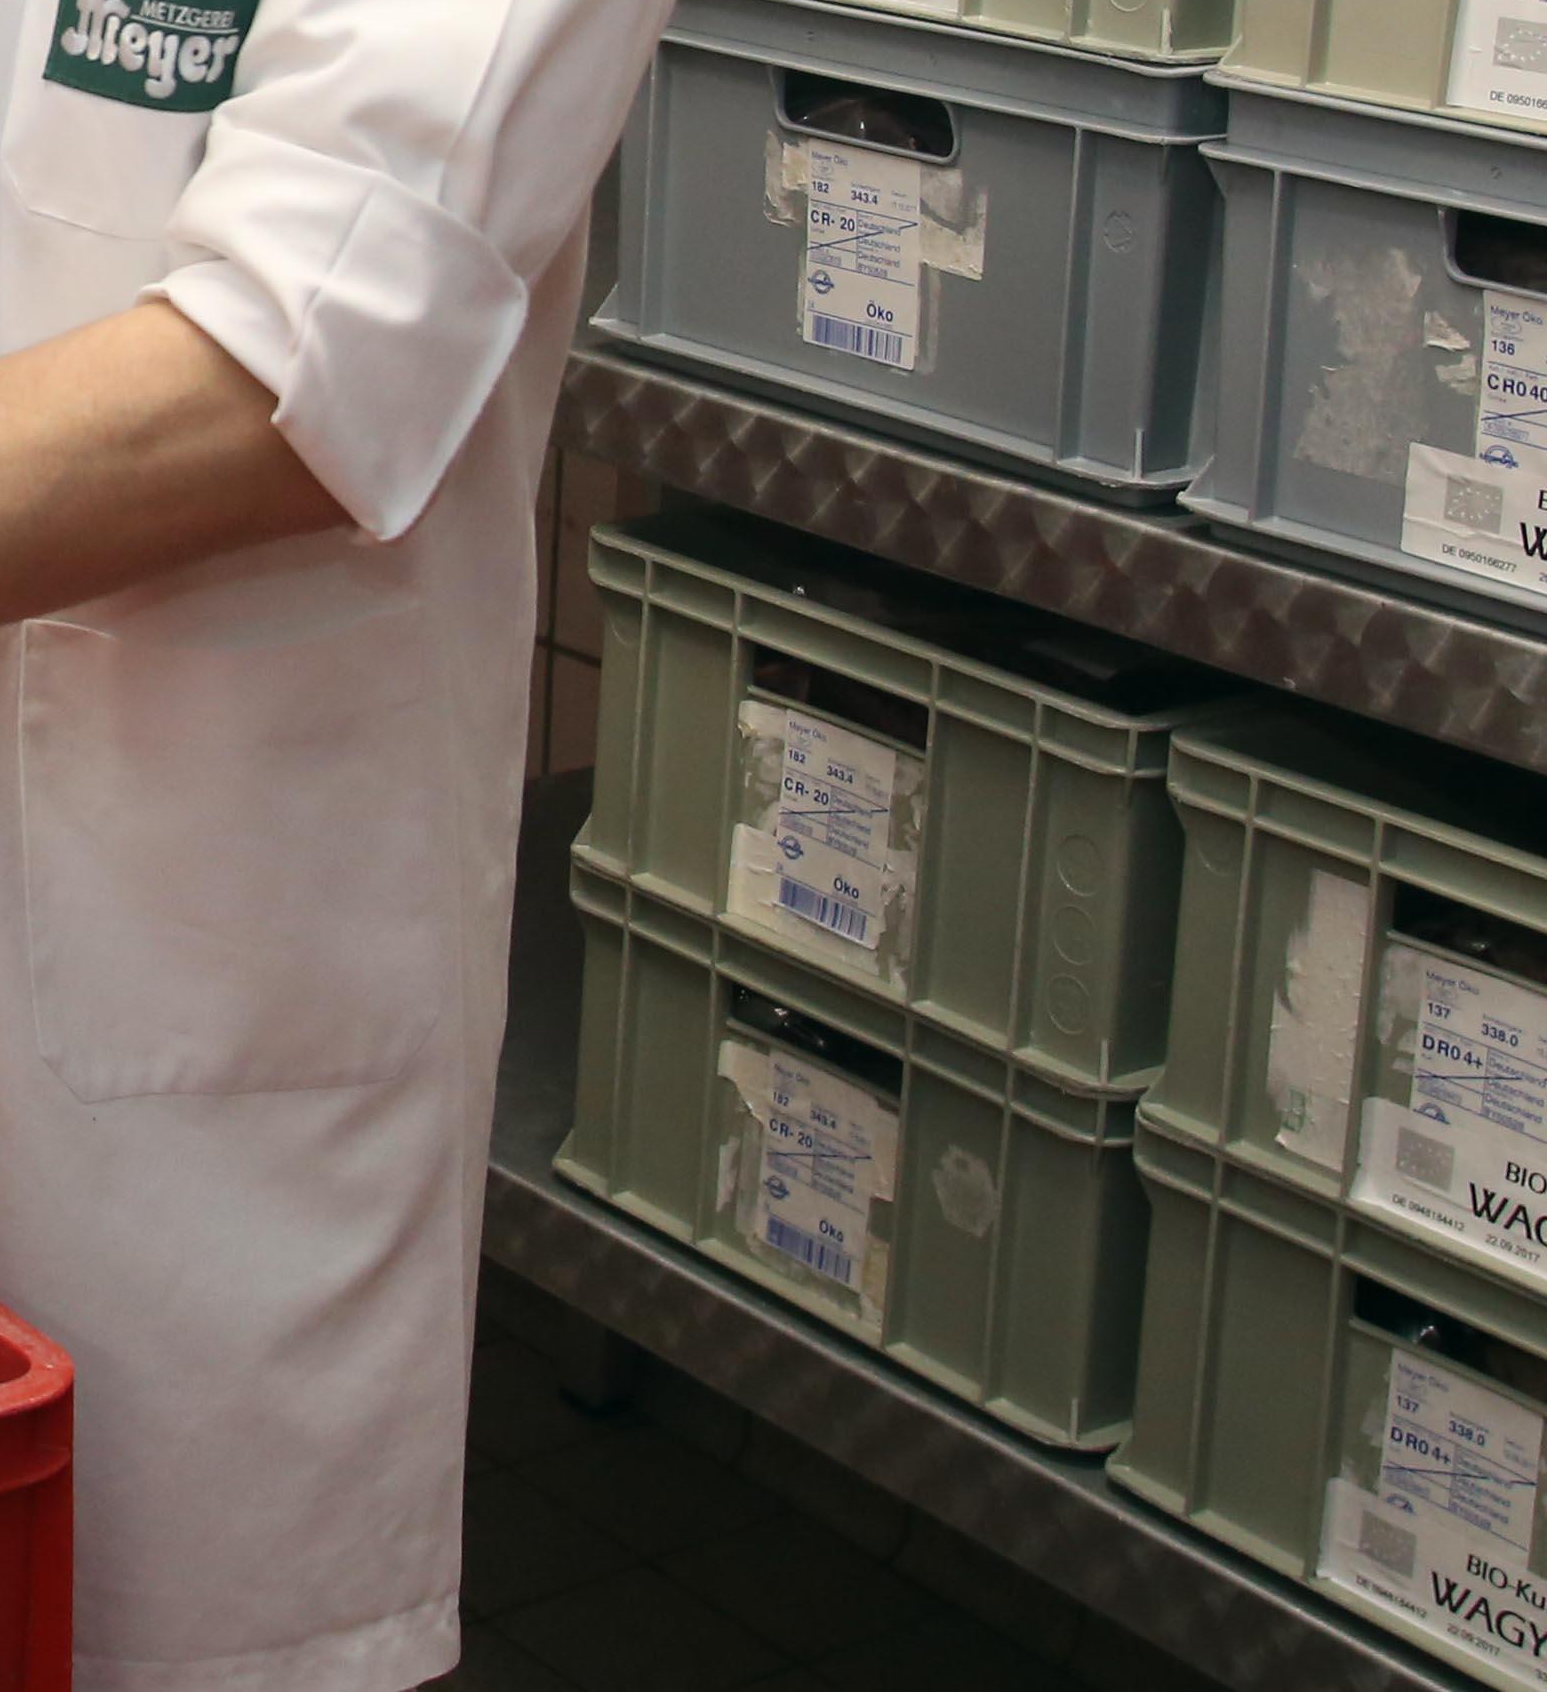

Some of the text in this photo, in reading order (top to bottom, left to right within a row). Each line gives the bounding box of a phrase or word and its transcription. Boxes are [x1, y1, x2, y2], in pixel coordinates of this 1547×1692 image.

[1489, 90, 1505, 102] DE
[812, 180, 878, 205] 182 343.4
[840, 216, 855, 232] 20
[857, 219, 901, 236] Deutschland
[867, 299, 893, 322] Öko
[1491, 304, 1544, 326] Meyer Öko
[1491, 339, 1516, 356] 136
[1442, 544, 1457, 557] DE
[789, 749, 853, 784] 182 343.4
[813, 789, 829, 806] 20
[1426, 970, 1456, 988] Meyer
[1427, 1002, 1519, 1048] 137 338.0
[797, 1132, 813, 1148] 20
[1392, 1194, 1407, 1208] DE
[1485, 1234, 1540, 1263] 22.09.2017
[1396, 1394, 1485, 1446] 137 338.0
